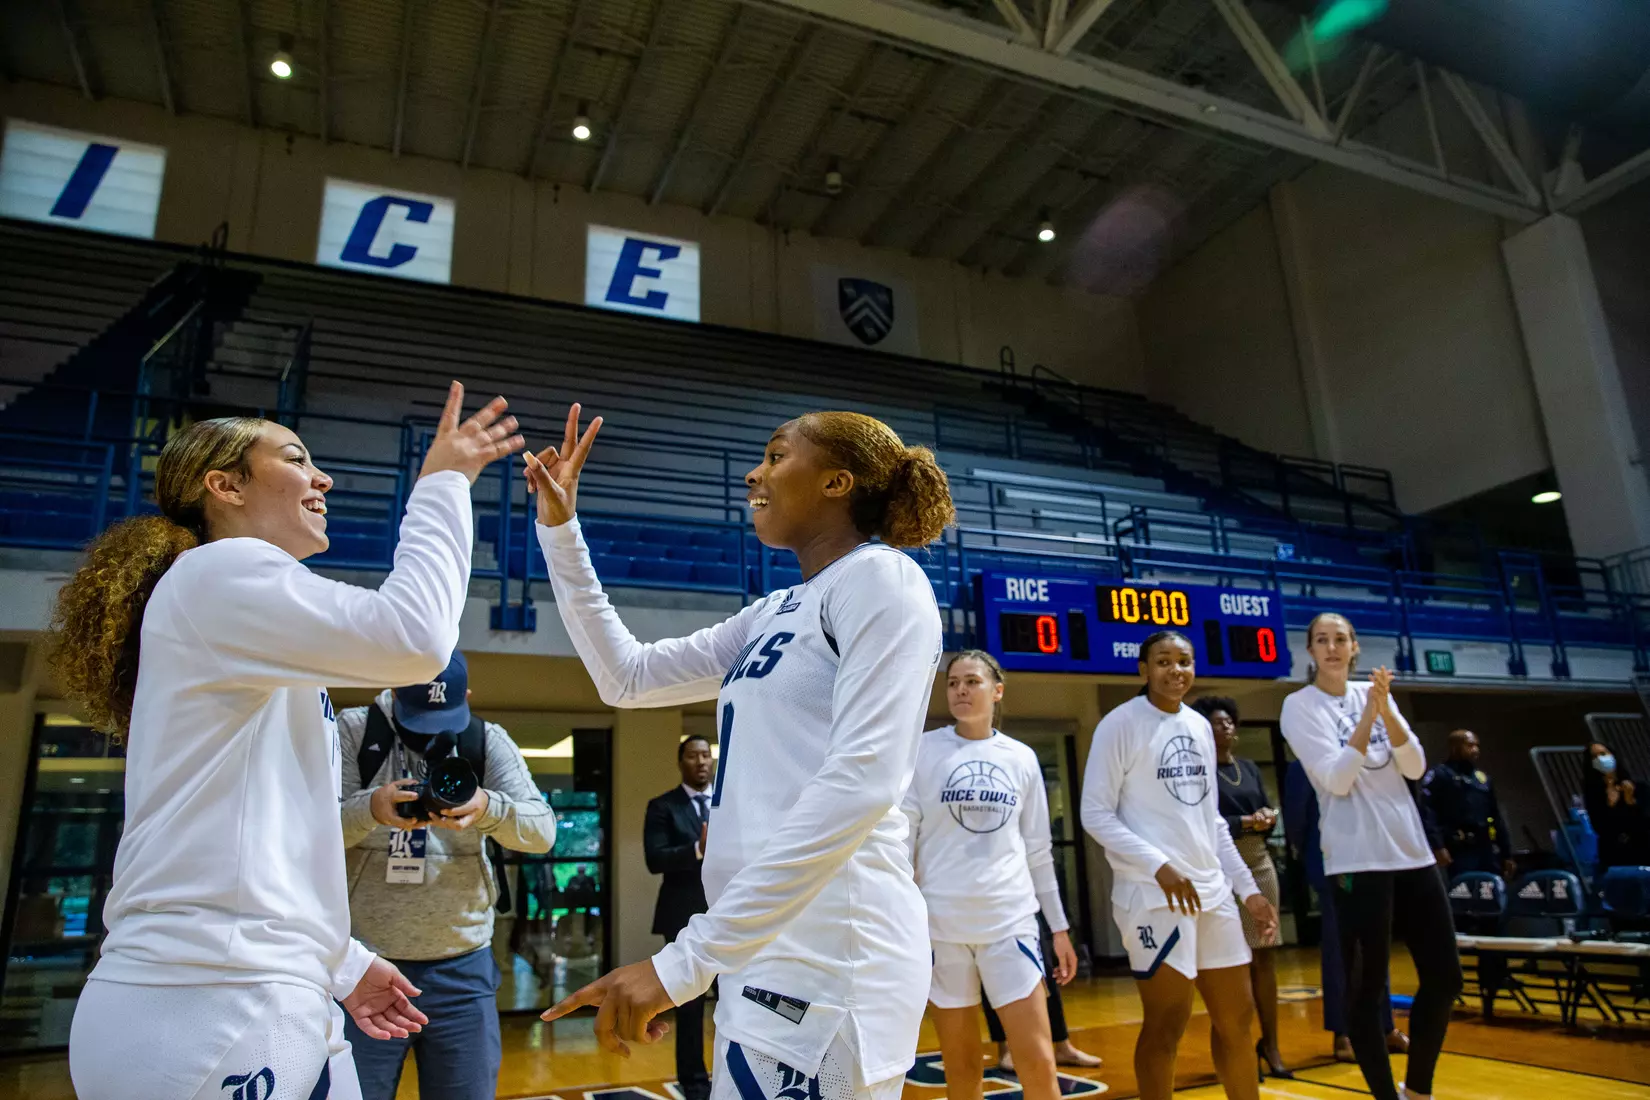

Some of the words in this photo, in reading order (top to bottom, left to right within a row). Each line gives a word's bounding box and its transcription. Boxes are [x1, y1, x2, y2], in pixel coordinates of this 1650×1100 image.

[340, 195, 434, 269] C
[605, 237, 682, 311] E
[1005, 577, 1050, 602] RICE
[1111, 587, 1190, 626] 10:00
[1219, 593, 1270, 618] GUEST
[1036, 615, 1058, 654] 0
[1257, 627, 1277, 663] 0
[1112, 641, 1141, 659] PERI
[428, 681, 447, 704] R
[1157, 766, 1183, 779] RICE
[940, 789, 976, 804] RICE
[979, 789, 1018, 807] OWLS
[962, 805, 1003, 813] BASKETBALL
[1137, 925, 1158, 949] R
